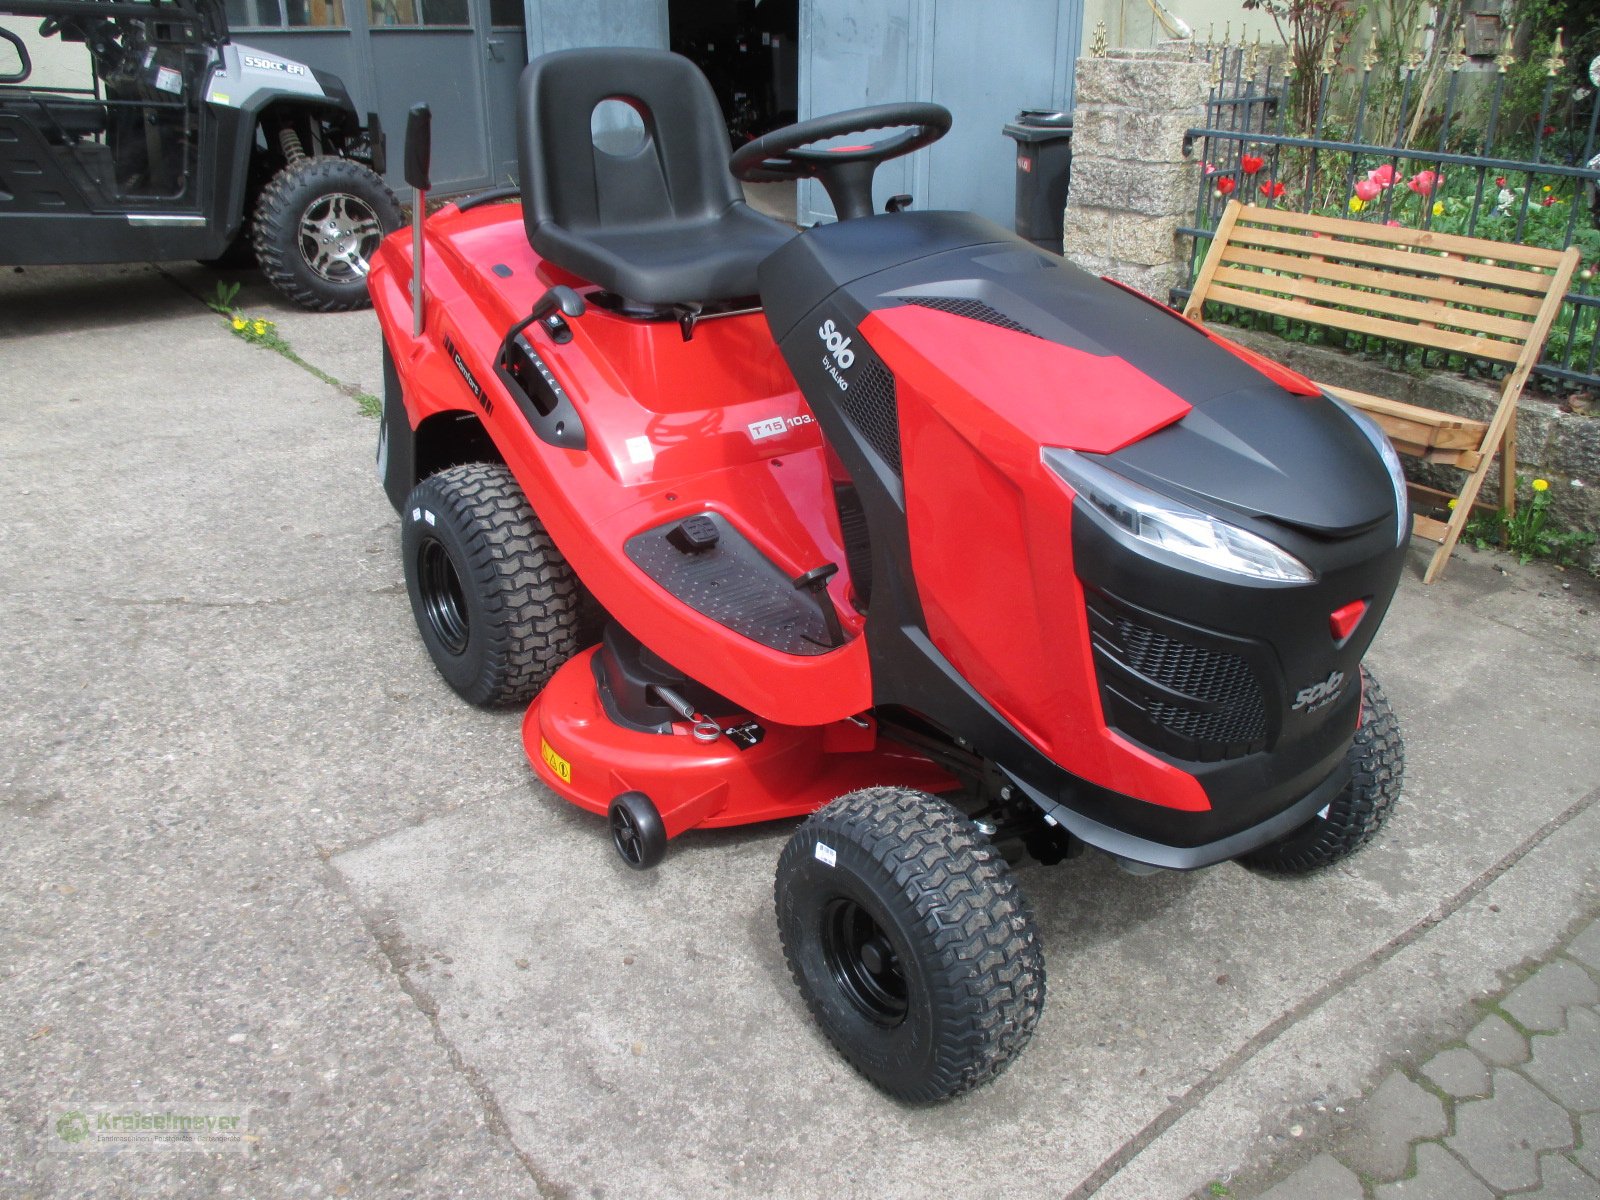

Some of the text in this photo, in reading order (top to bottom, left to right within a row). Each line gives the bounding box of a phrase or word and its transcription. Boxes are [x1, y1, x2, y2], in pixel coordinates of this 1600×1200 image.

[244, 56, 305, 76] 550cc EFI
[822, 355, 832, 371] by
[454, 354, 479, 395] Comfort
[765, 421, 782, 432] 15
[786, 414, 817, 427] 103.
